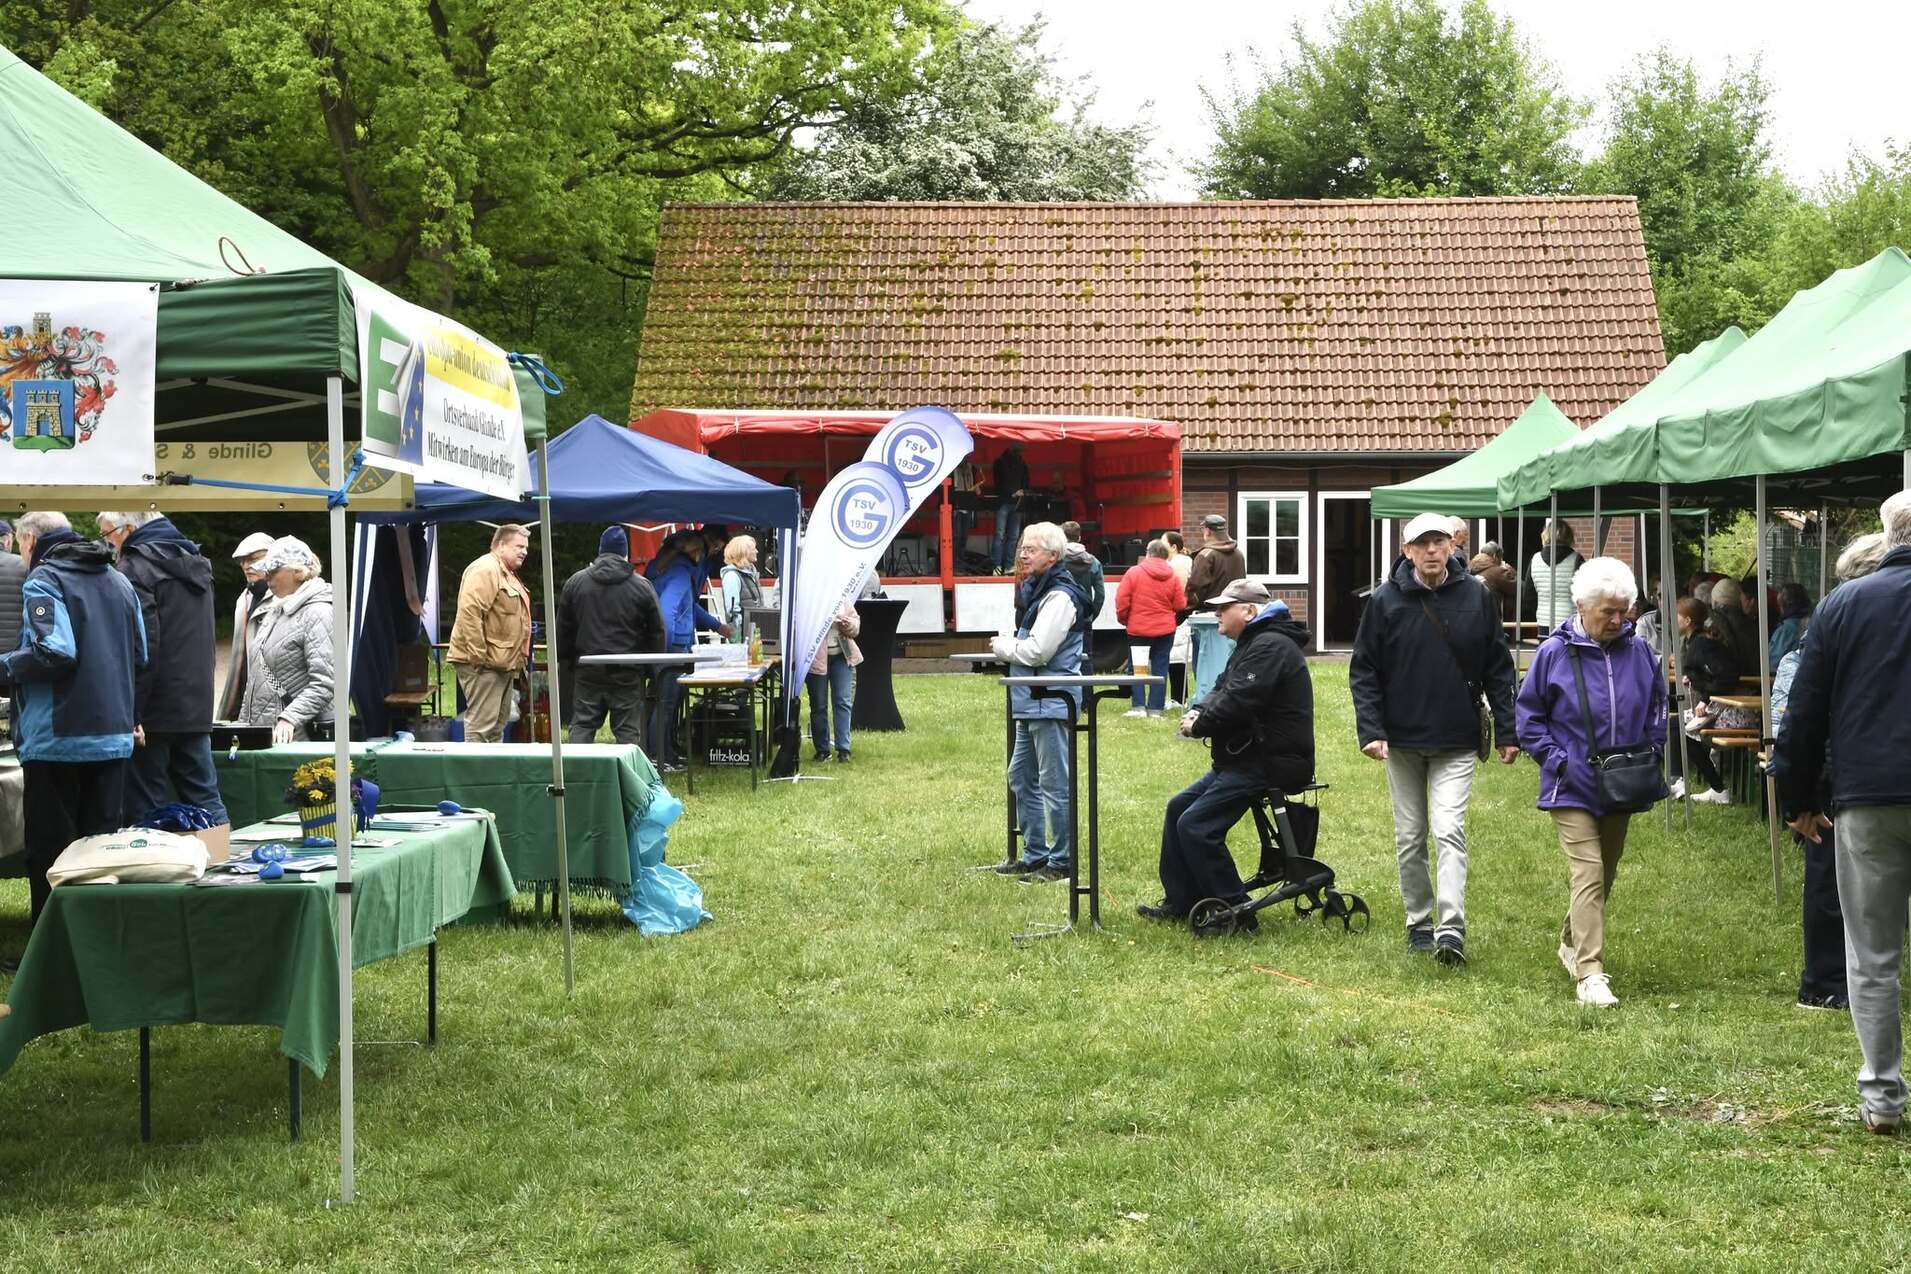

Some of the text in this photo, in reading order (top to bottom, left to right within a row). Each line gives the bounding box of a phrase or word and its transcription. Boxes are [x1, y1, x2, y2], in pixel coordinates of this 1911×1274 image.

[444, 398, 479, 432] Ortsverband
[905, 440, 927, 453] TSV
[427, 431, 515, 485] Mitwirken am Europa der Bürger
[897, 458, 919, 472] 1930
[853, 498, 876, 510] TSV
[850, 519, 872, 530] 1930
[804, 646, 816, 664] TSV
[842, 578, 856, 598] 1930
[710, 748, 749, 761] fritz-kola
